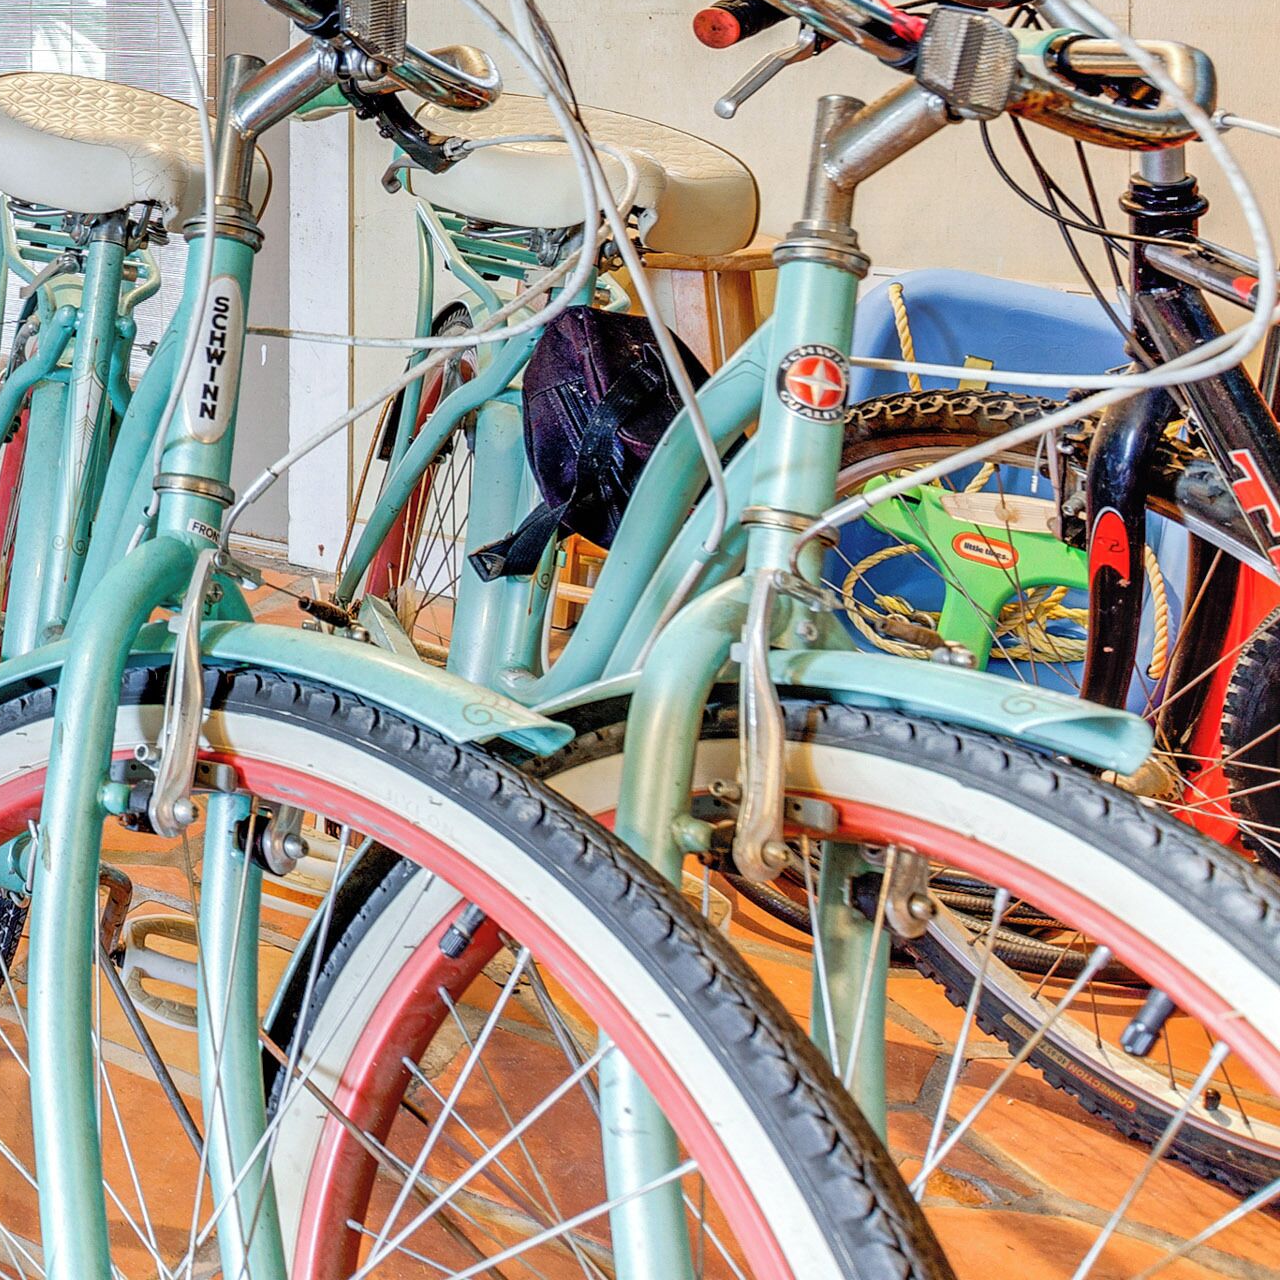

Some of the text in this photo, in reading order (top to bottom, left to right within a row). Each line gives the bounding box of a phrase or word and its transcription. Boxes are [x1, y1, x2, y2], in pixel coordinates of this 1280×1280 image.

[199, 296, 230, 421] SCHWINN
[963, 542, 984, 554] little
[1069, 1063, 1136, 1111] CONNECTION
